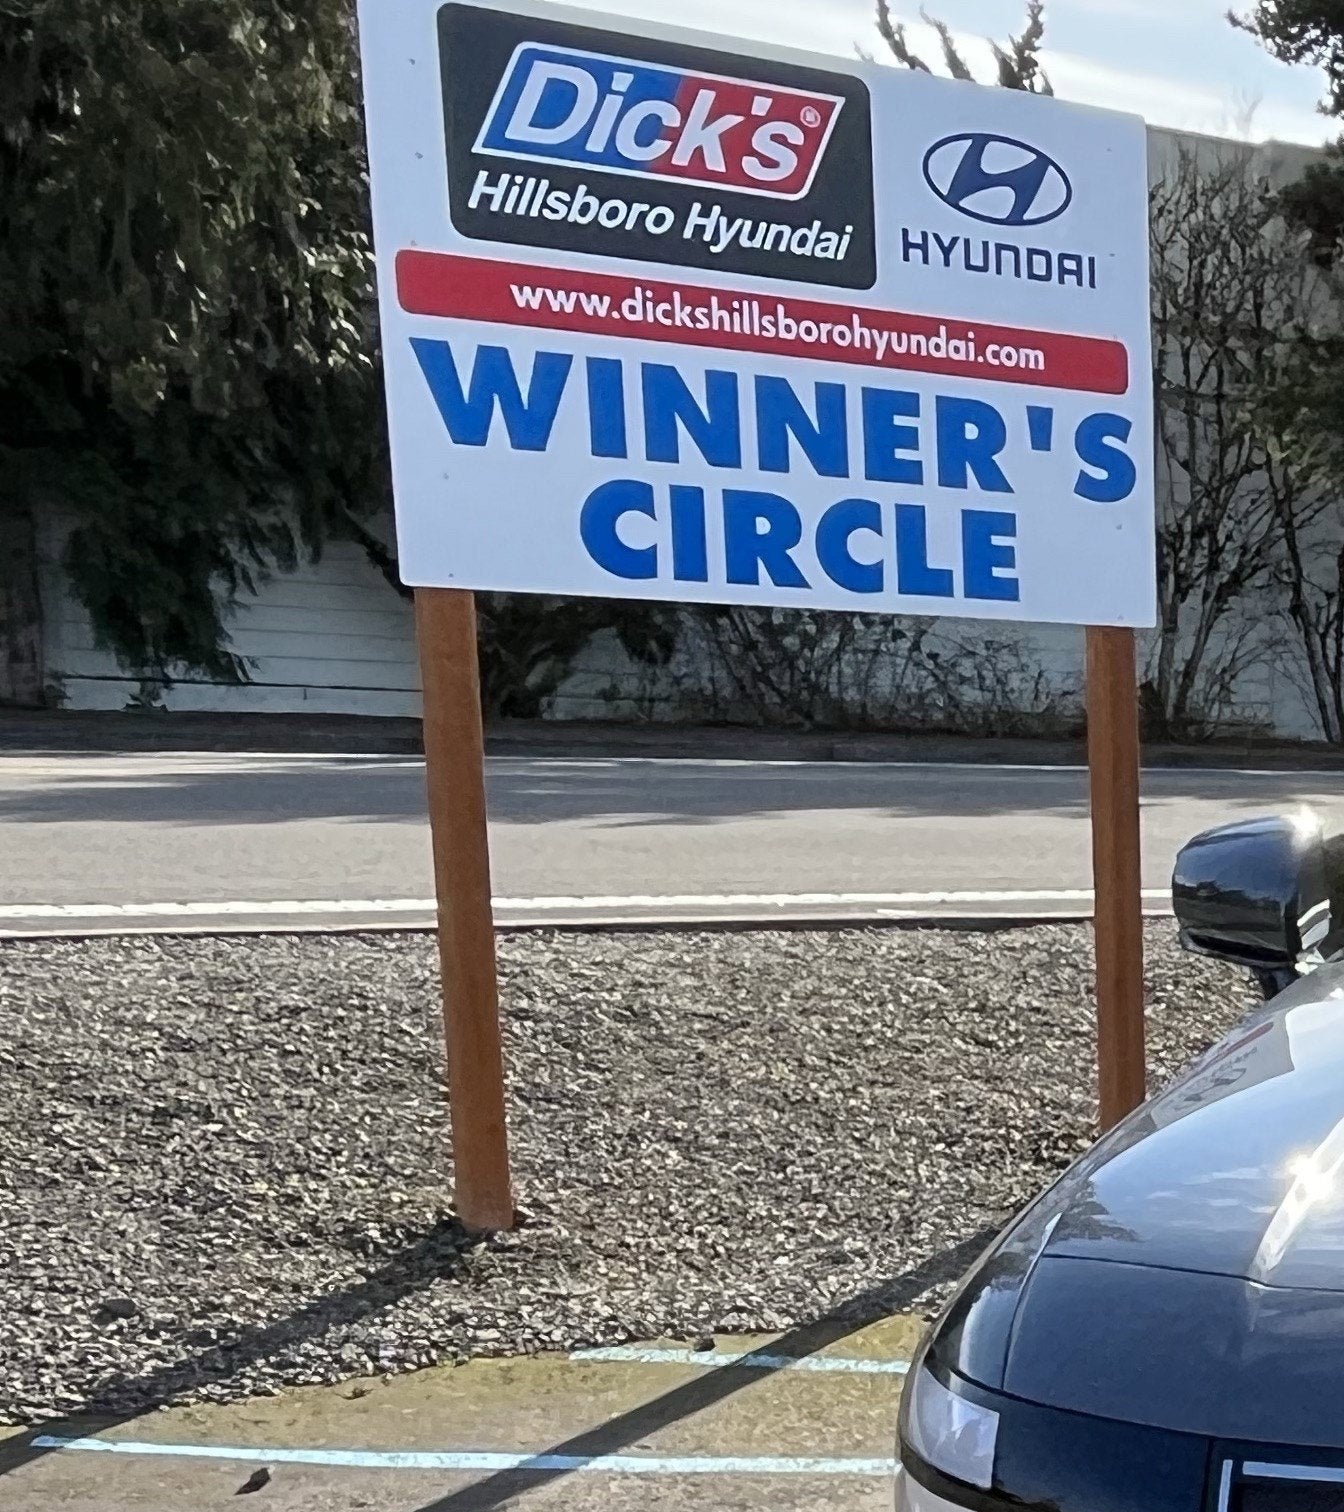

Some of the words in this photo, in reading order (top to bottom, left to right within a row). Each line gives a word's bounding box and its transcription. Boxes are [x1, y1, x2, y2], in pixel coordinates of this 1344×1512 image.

[504, 61, 805, 183] Dick's
[467, 170, 675, 235] Hillsboro
[683, 202, 853, 261] Hyundai
[902, 228, 1096, 289] HYUNDAI
[510, 280, 1046, 371] www.dickshillsborohyundai.com
[408, 336, 1137, 503] WINNER'S
[579, 479, 1020, 603] CIRCLE
